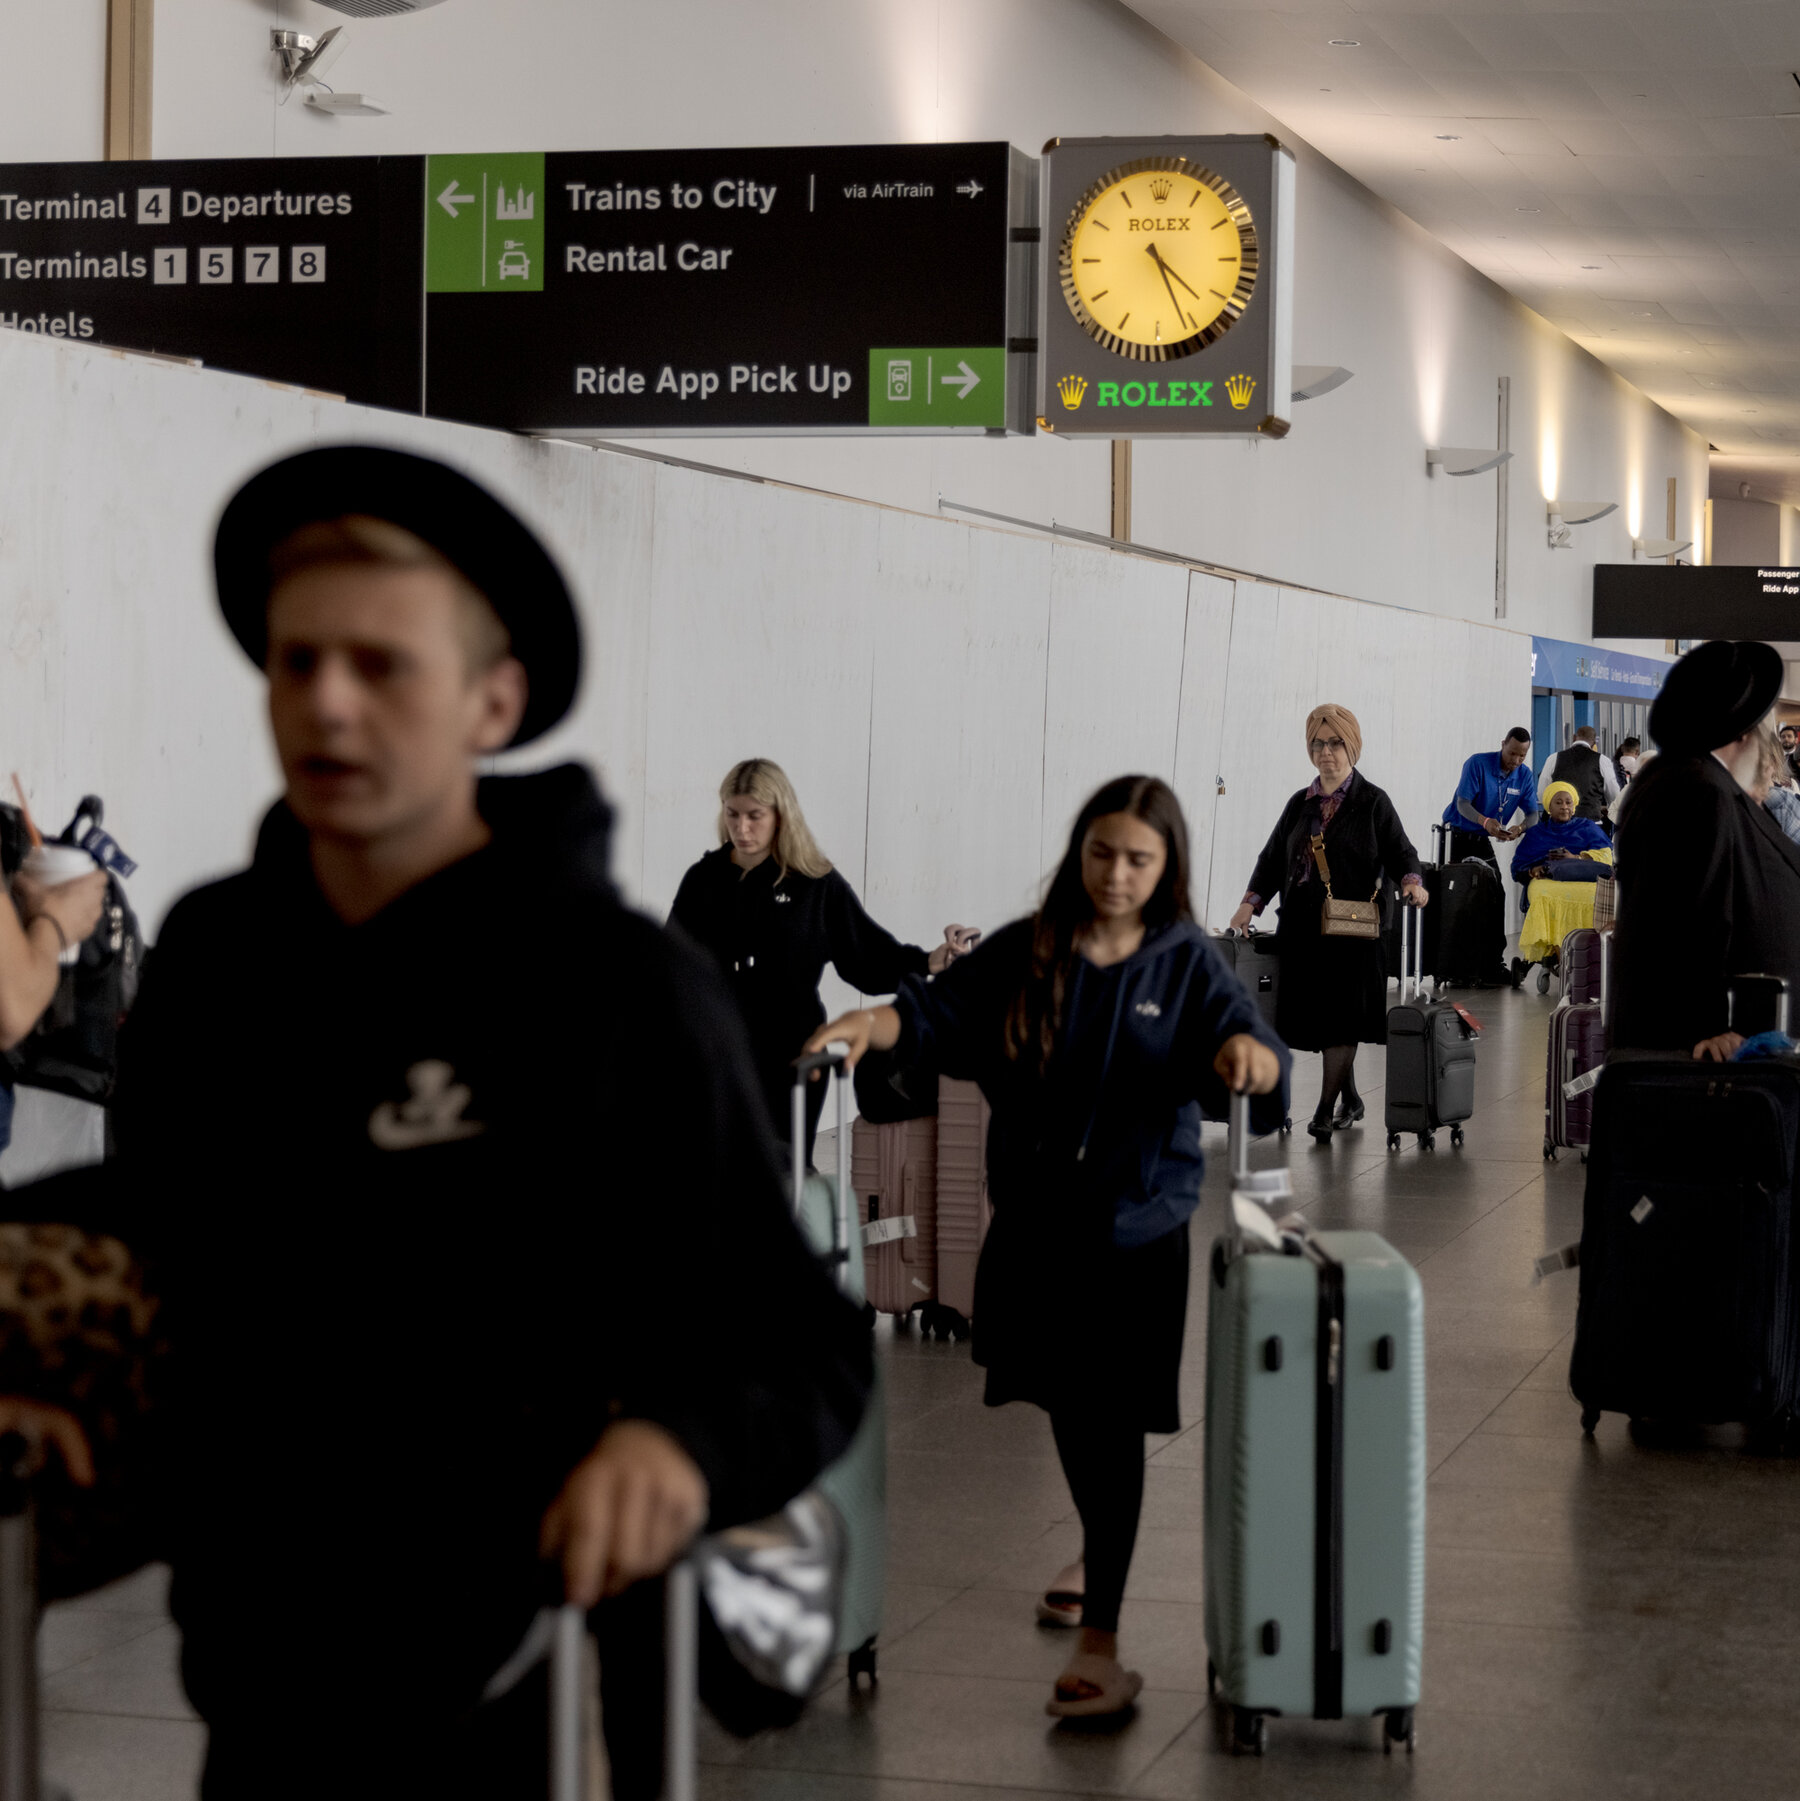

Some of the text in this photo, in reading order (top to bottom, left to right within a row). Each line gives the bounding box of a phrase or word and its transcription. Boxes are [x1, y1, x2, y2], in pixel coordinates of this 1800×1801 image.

[566, 180, 777, 215] Trains to City
[843, 184, 934, 199] via AirTrain
[0, 192, 126, 220] Terminal
[182, 190, 352, 223] Departures
[1128, 218, 1191, 231] ROLEX
[0, 251, 147, 279] Terminals
[566, 243, 733, 273] Rental Car
[0, 311, 94, 338] Hotels
[575, 365, 852, 401] Ride App Pick Up
[1097, 381, 1214, 408] ROLEX
[1757, 569, 1799, 579] Passenger
[1762, 584, 1800, 595] Ride App
